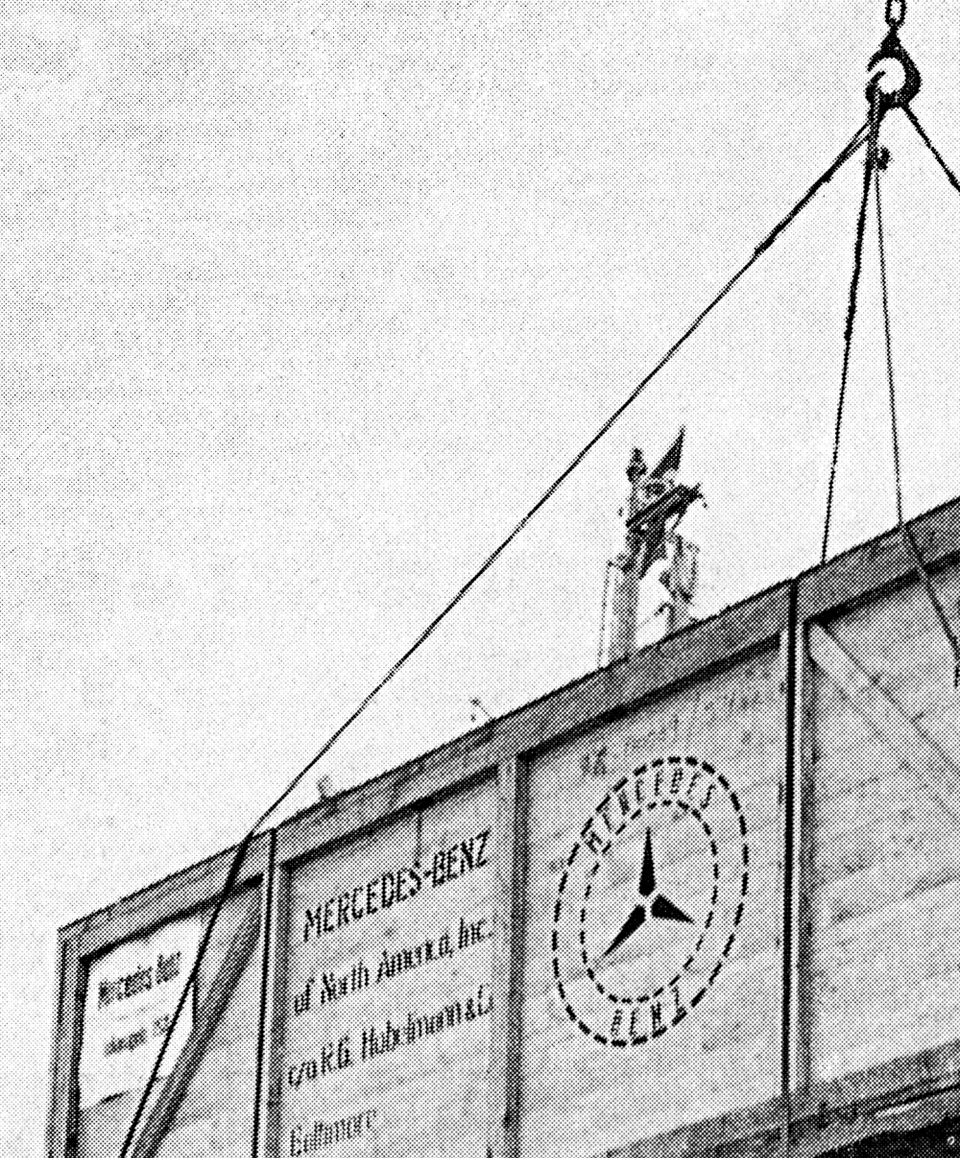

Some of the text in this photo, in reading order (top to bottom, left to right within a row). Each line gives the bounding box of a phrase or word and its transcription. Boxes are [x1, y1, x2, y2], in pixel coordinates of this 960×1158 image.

[584, 767, 716, 855] MERCEDES
[303, 828, 491, 943] MERCEDES-BENZ
[293, 974, 314, 1018] of
[321, 958, 371, 1008] North
